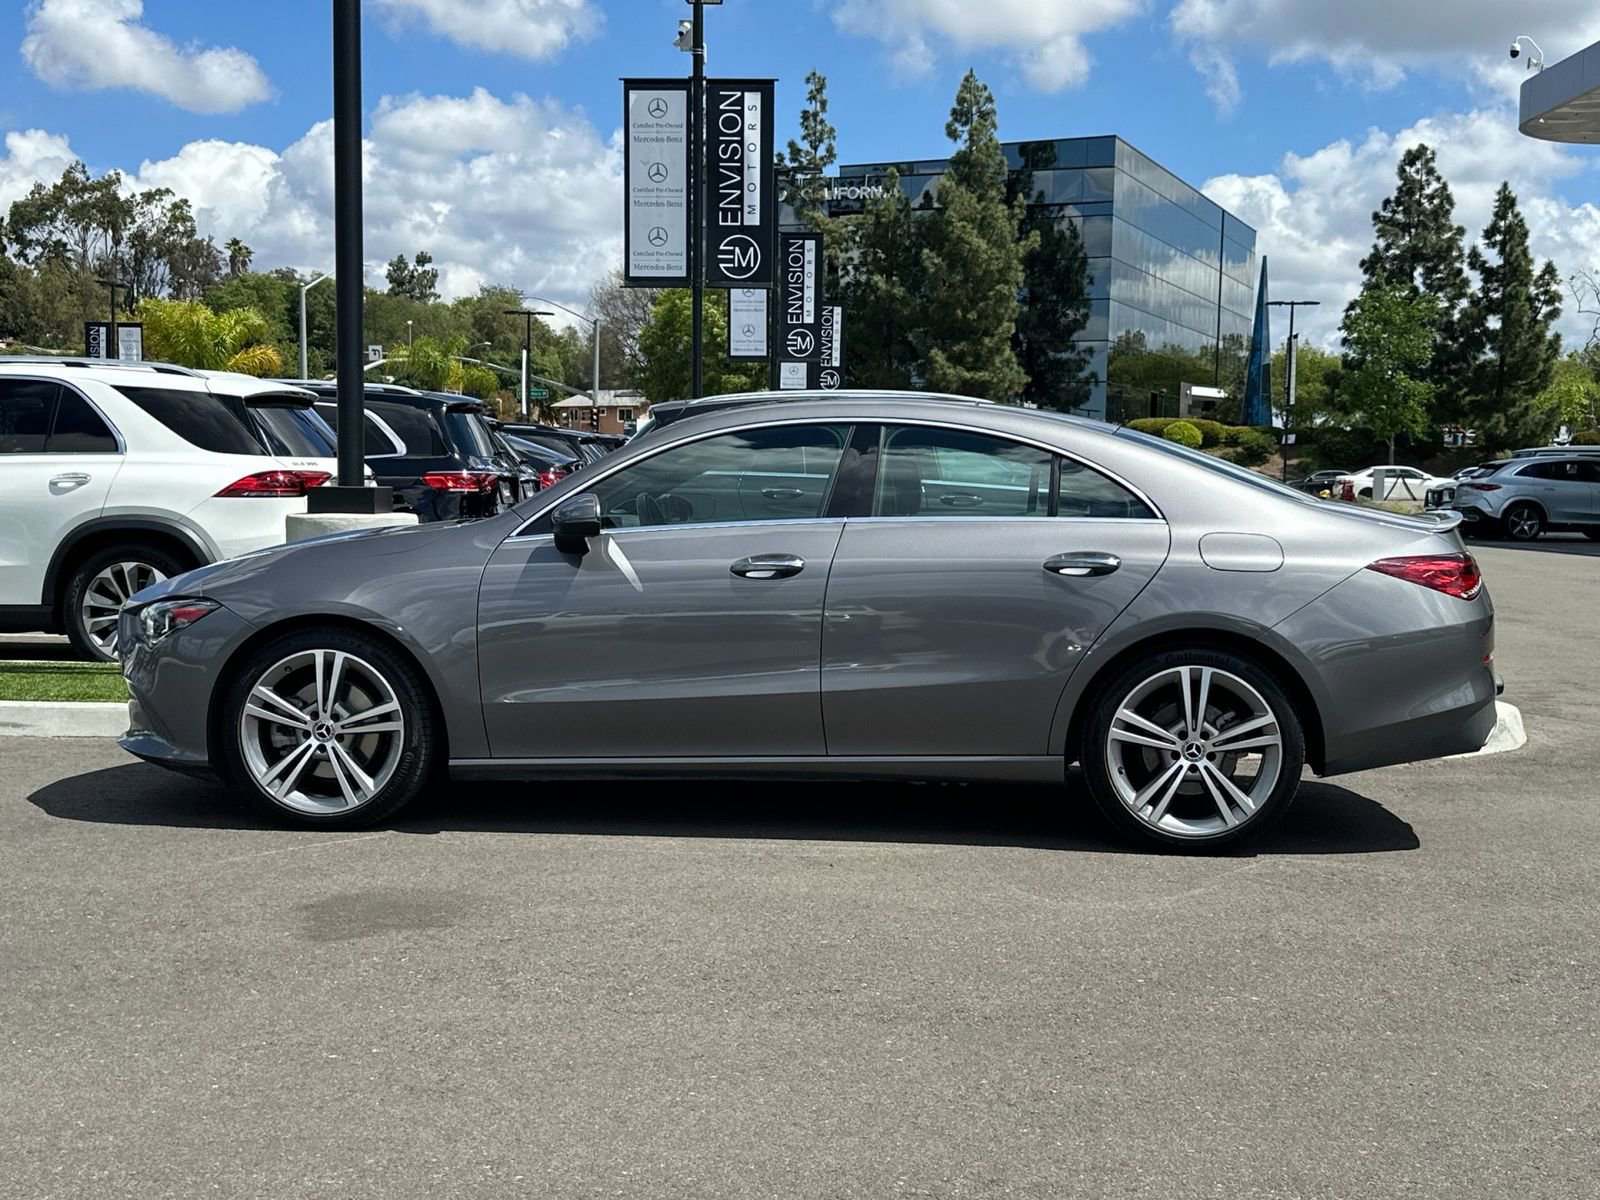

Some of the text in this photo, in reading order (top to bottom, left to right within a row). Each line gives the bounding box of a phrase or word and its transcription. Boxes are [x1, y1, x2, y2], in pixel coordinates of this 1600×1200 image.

[633, 135, 683, 143] Mercedes-Benz
[718, 91, 742, 226] ENVISION
[746, 104, 758, 215] MOTORS
[633, 199, 683, 208] Mercedes-Benz
[800, 185, 899, 202] CLIFORN
[633, 263, 683, 271] Mercedes-Benz
[787, 239, 804, 324] ENVISION
[805, 247, 814, 317] MOTORS
[820, 305, 834, 367] ENVISION
